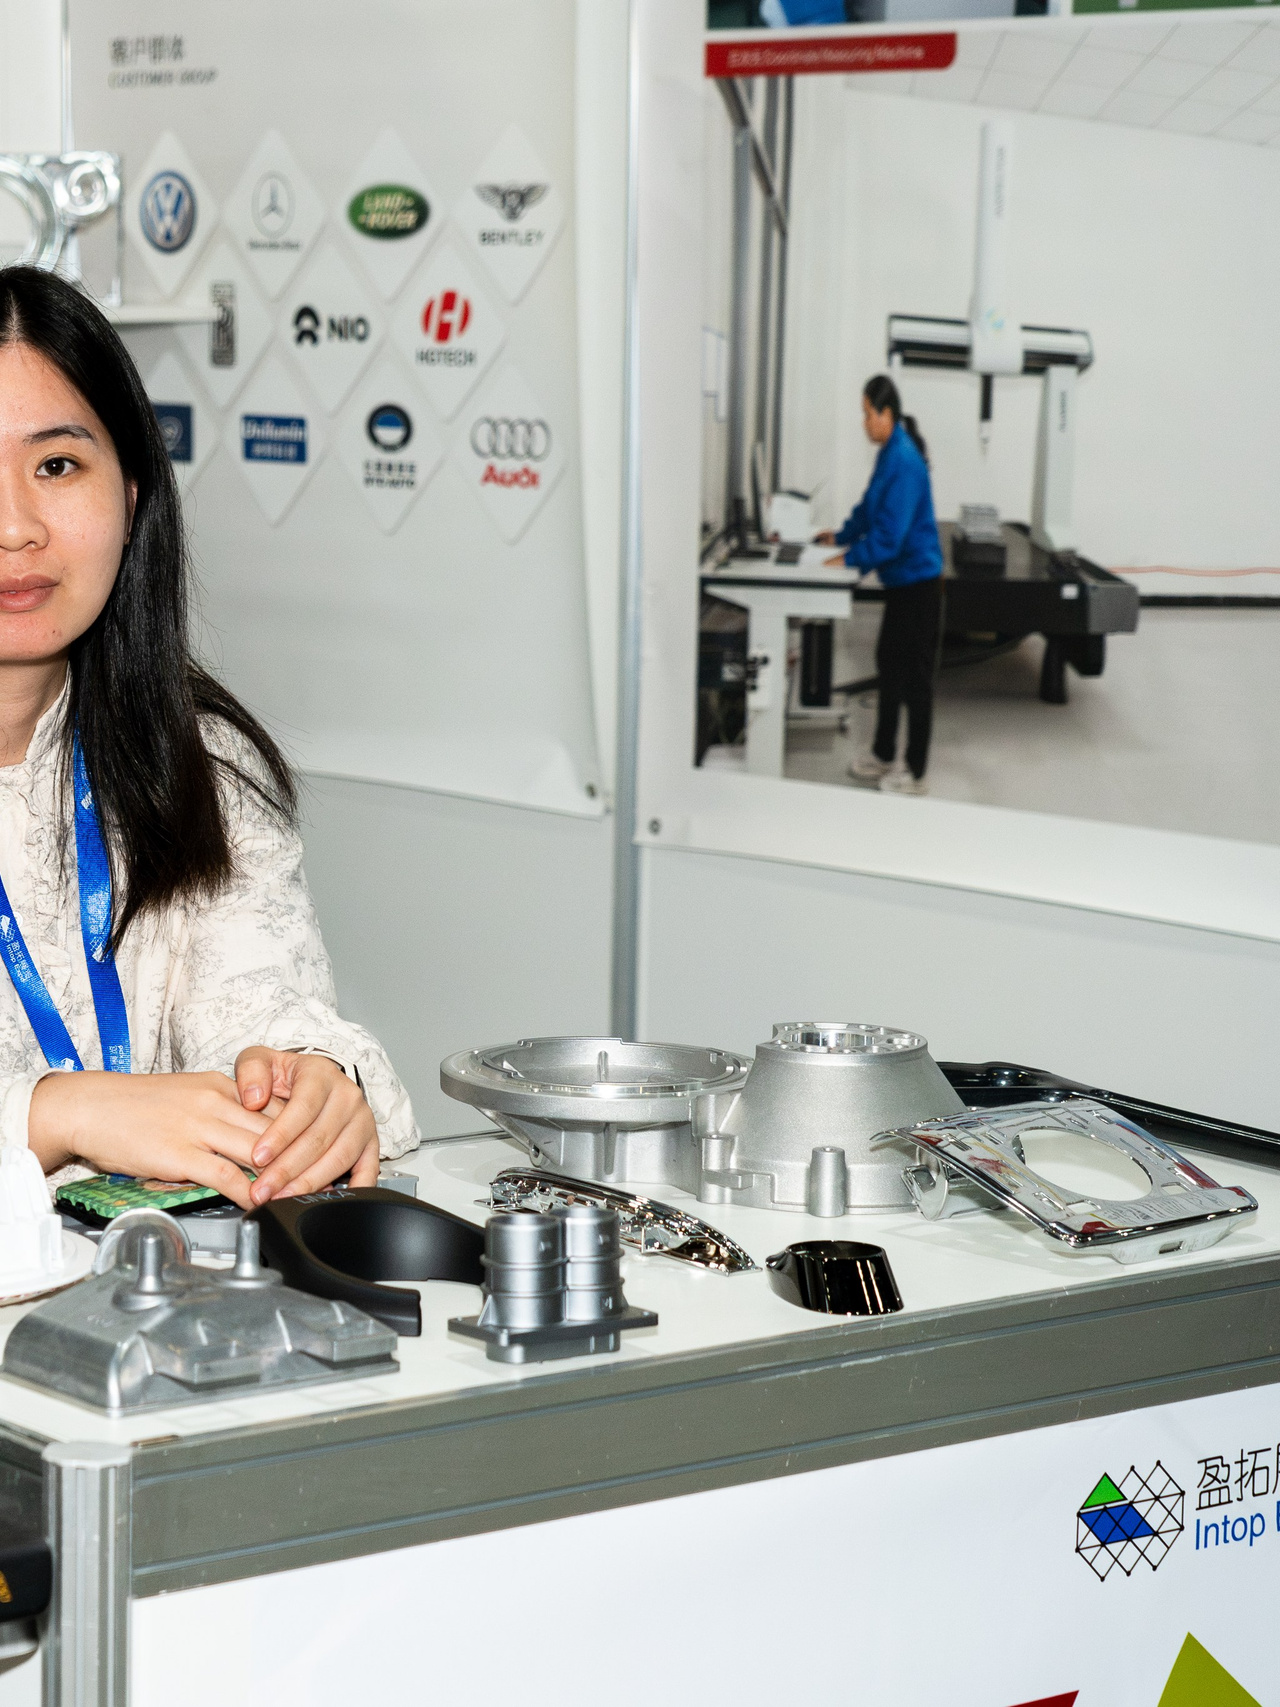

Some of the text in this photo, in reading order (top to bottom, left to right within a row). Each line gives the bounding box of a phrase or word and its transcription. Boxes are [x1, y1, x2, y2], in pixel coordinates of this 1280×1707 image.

[479, 230, 544, 246] BENTLEY
[327, 315, 371, 343] NIO
[480, 462, 541, 489] Audi
[1195, 1442, 1280, 1511] 盈拓
[1195, 1512, 1266, 1551] Intop
